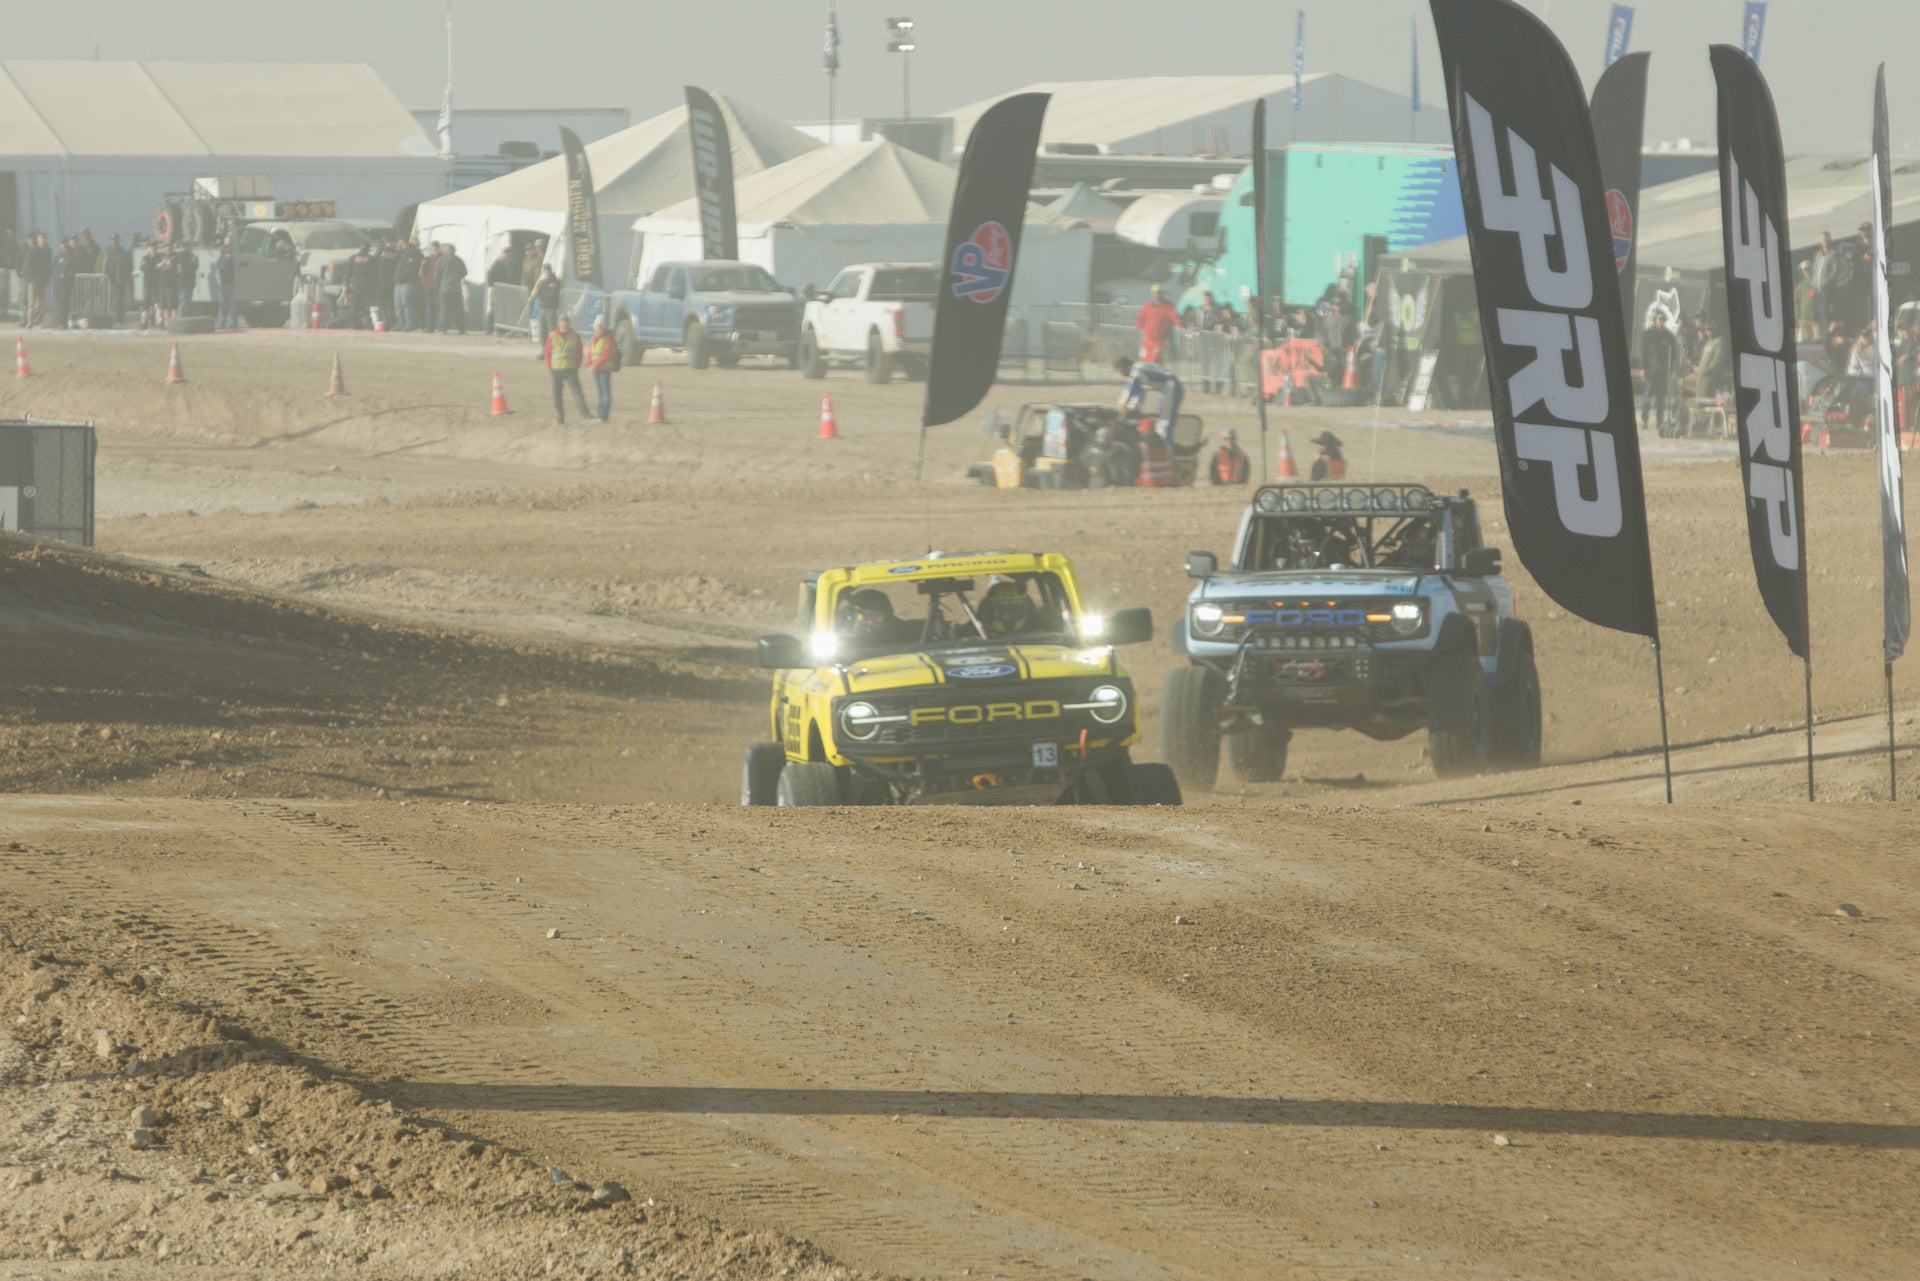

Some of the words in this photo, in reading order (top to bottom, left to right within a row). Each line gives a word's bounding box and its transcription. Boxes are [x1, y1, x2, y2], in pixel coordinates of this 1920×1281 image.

[569, 179, 587, 232] MADDEN
[577, 238, 592, 277] TERRY
[951, 242, 1009, 297] VP
[927, 558, 1007, 569] RACING
[1245, 609, 1366, 627] FORD
[910, 700, 1061, 726] FORD
[1037, 747, 1057, 763] 13
